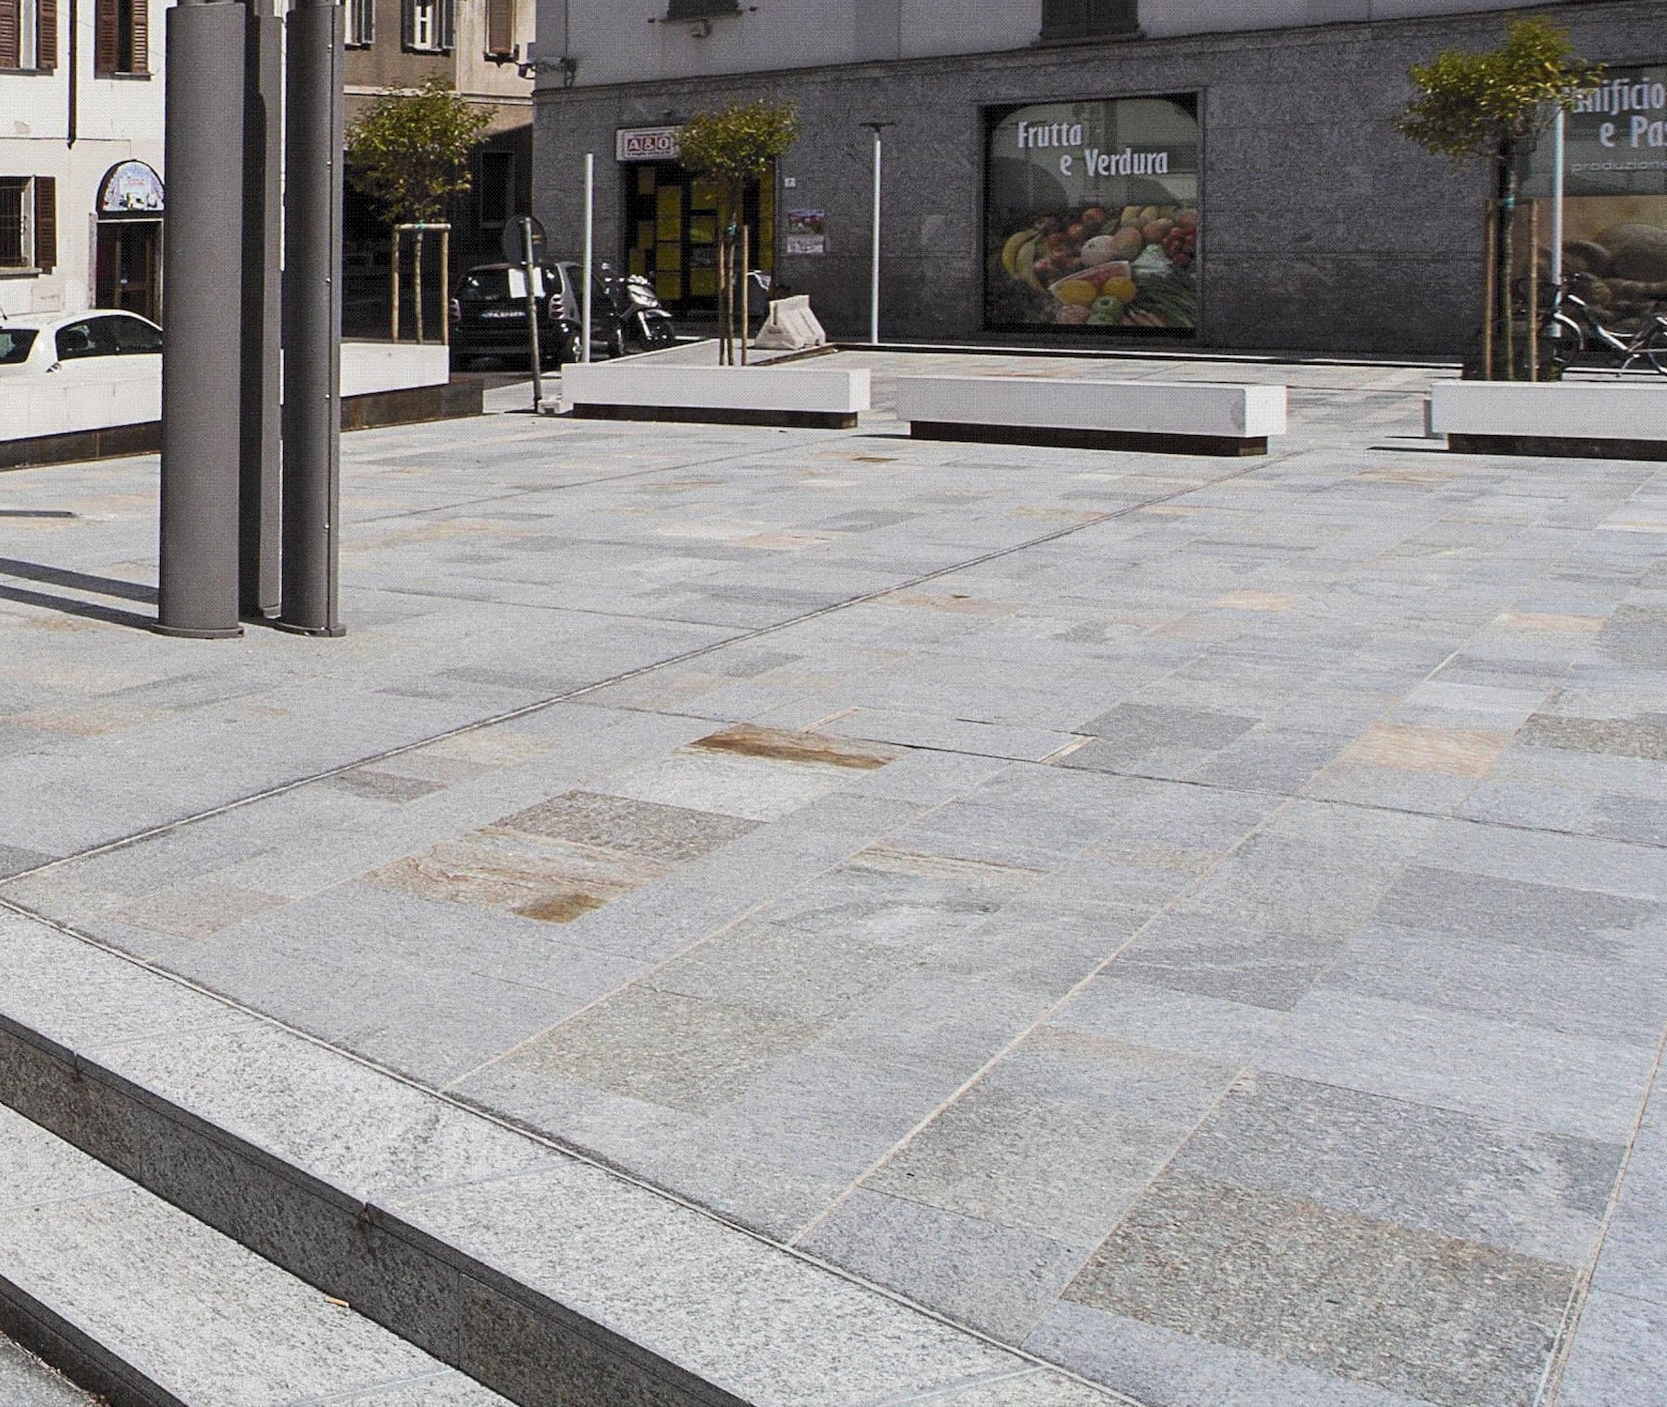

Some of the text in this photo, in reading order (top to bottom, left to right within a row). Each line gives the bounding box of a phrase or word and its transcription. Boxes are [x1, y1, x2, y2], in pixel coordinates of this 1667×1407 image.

[1562, 76, 1666, 115] anificio
[627, 135, 671, 152] A&O
[1017, 120, 1083, 149] Frutta
[1600, 114, 1667, 148] e Pa
[1059, 147, 1170, 177] e Verdura
